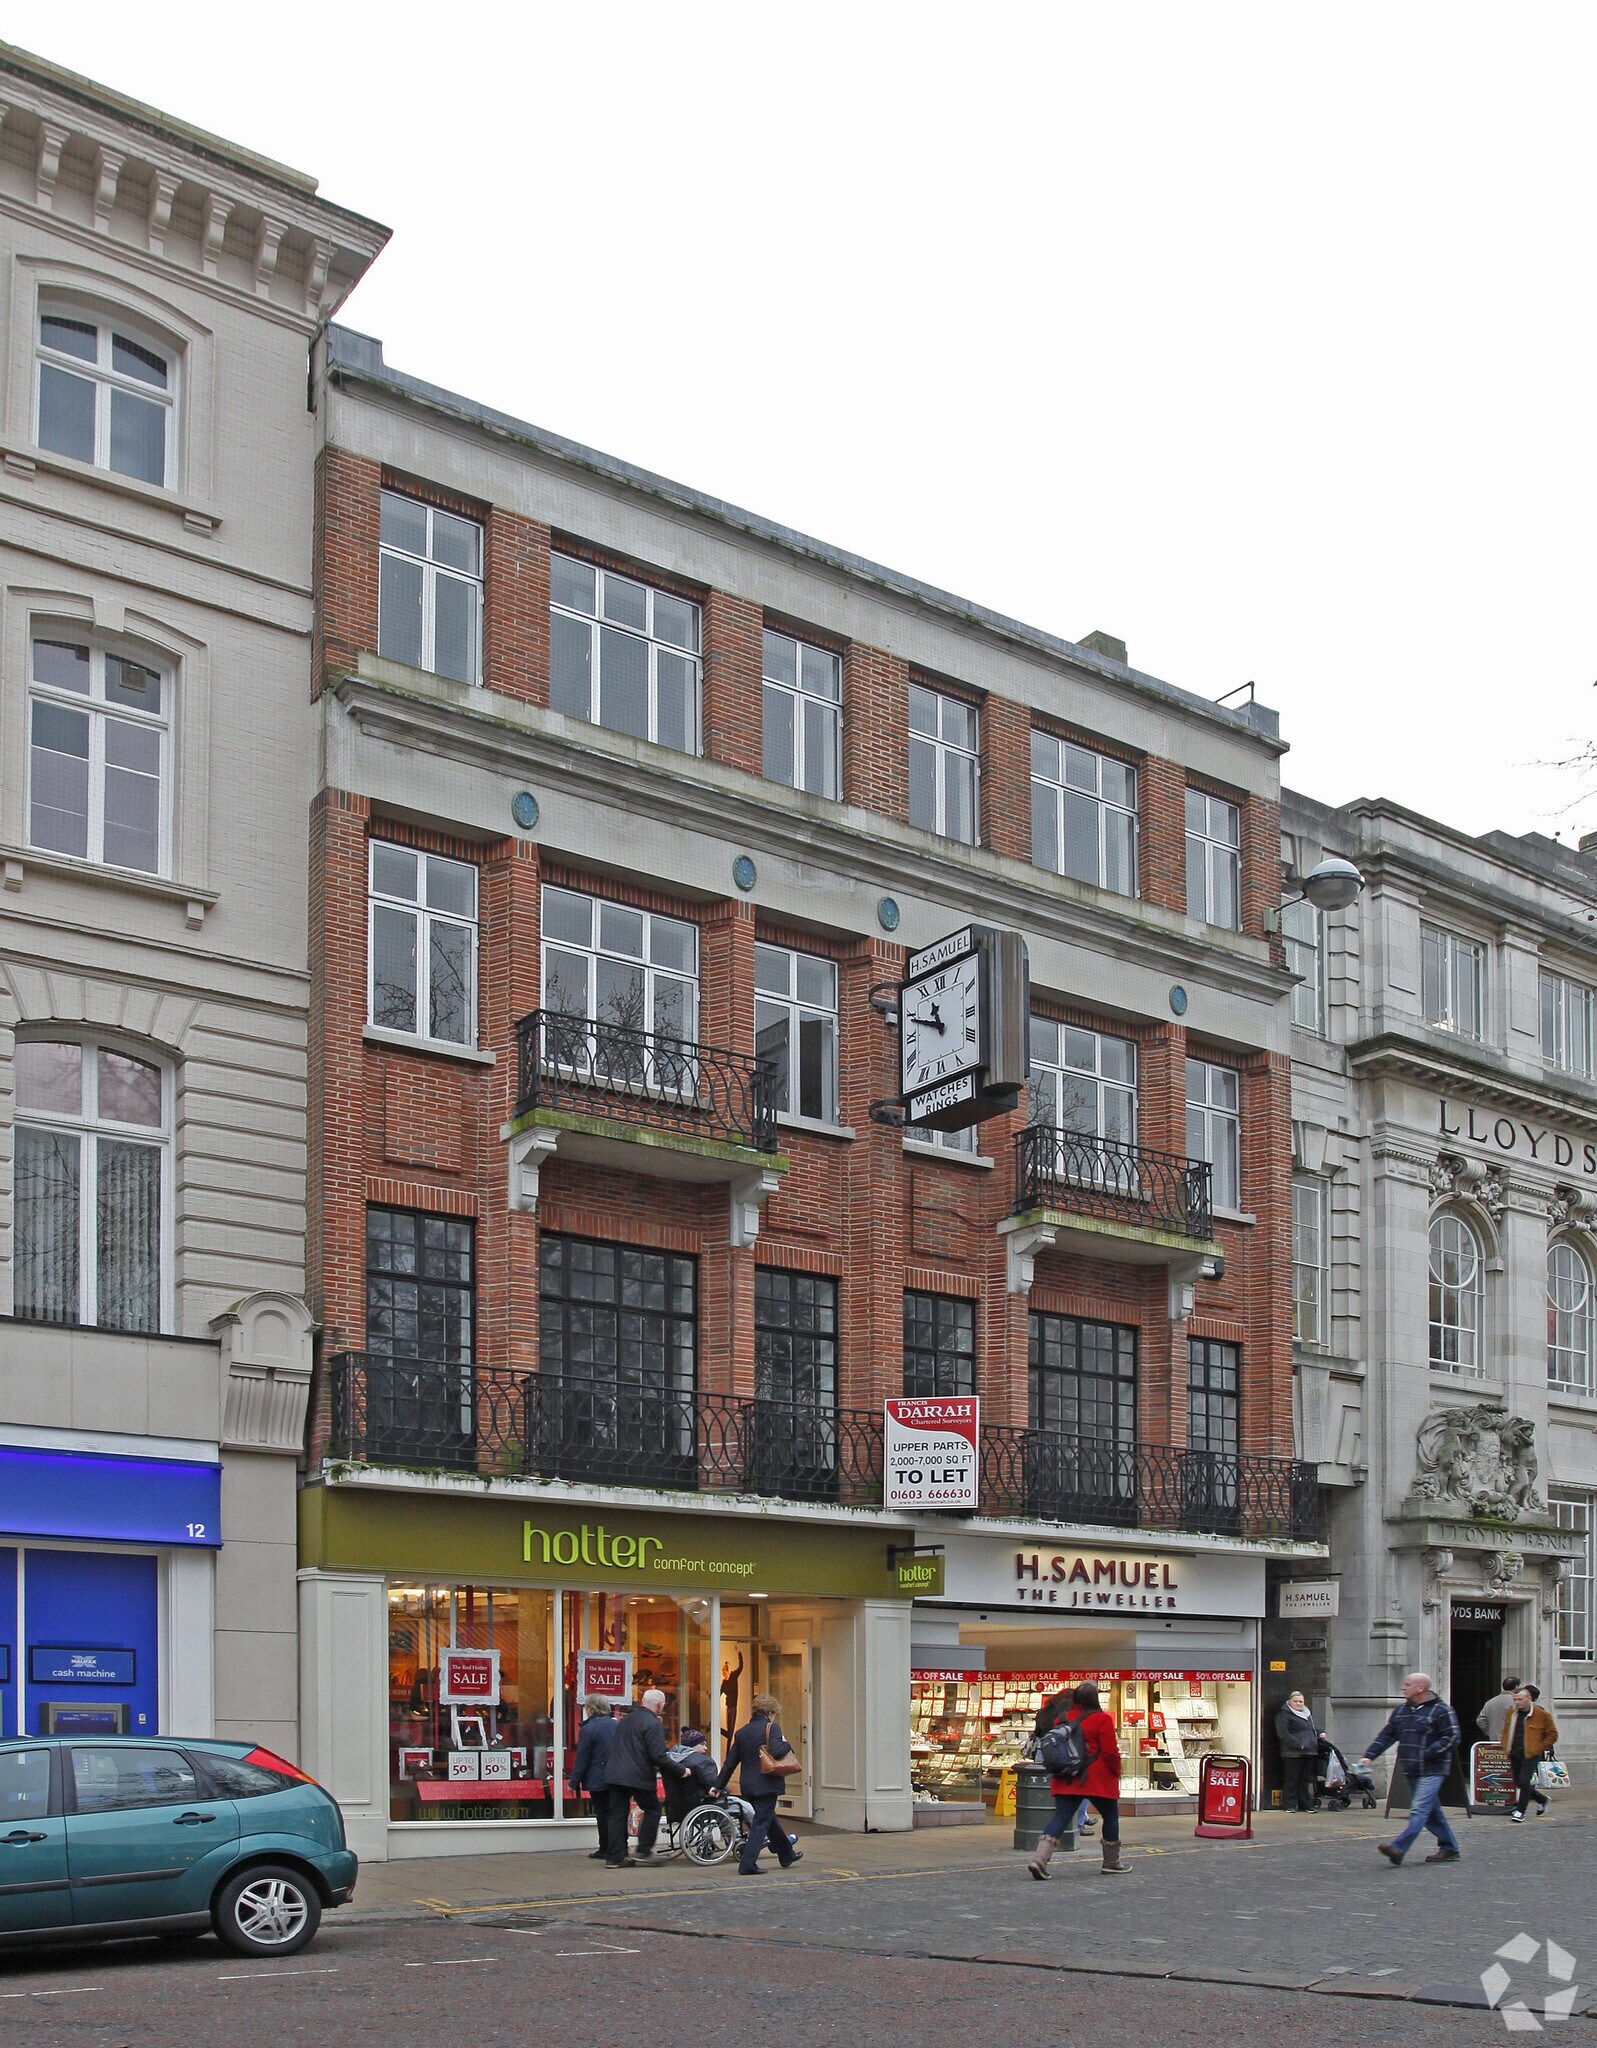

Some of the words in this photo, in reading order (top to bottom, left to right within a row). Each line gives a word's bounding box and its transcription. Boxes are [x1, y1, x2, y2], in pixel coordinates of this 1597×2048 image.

[911, 936, 969, 973] H.SAMUEL
[915, 1077, 968, 1106] WATCHES
[926, 1094, 958, 1114] RINGS
[1439, 1099, 1597, 1174] LLOYDS
[897, 1405, 971, 1418] DARRAH
[893, 1443, 929, 1452] UPPER
[934, 1441, 968, 1450] PARTS
[890, 1455, 942, 1467] 2,000-7,000
[946, 1455, 958, 1464] SQ
[962, 1454, 972, 1463] FT
[895, 1470, 923, 1484] TO
[930, 1469, 968, 1483] LET
[890, 1490, 922, 1499] 01603
[928, 1489, 971, 1498] 666630
[186, 1523, 205, 1537] 12
[1440, 1524, 1514, 1543] LLOYDS
[523, 1520, 663, 1569] hotter
[653, 1557, 705, 1571] comfort
[709, 1561, 754, 1577] concept
[1017, 1553, 1178, 1589] H.SAMUEL
[899, 1565, 936, 1581] hotter
[1017, 1588, 1057, 1601] THE
[1072, 1591, 1177, 1607] JEWELLER
[1285, 1593, 1330, 1602] H.SAMUEL
[1475, 1608, 1501, 1619] BANK
[52, 1669, 74, 1677] cash
[77, 1669, 116, 1678] machine
[453, 1673, 488, 1685] SALE
[923, 1672, 938, 1680] OFF
[940, 1672, 963, 1680] SALE
[1026, 1672, 1038, 1680] OFF
[1069, 1672, 1084, 1680] 50%
[1085, 1672, 1098, 1680] OFF
[1099, 1672, 1120, 1680] SALE
[1132, 1672, 1148, 1680] 50%
[1149, 1672, 1162, 1680] OFF
[1163, 1672, 1184, 1680] SALE
[1196, 1672, 1211, 1680] 50%
[1212, 1672, 1225, 1680] OFF
[589, 1674, 621, 1685] SALE
[1043, 1683, 1065, 1691] SALE
[453, 1764, 475, 1775] 50%
[485, 1764, 507, 1775] 50%
[1211, 1770, 1226, 1778] 50%
[1210, 1777, 1239, 1786] SALE
[418, 1806, 529, 1819] www.hotter.com
